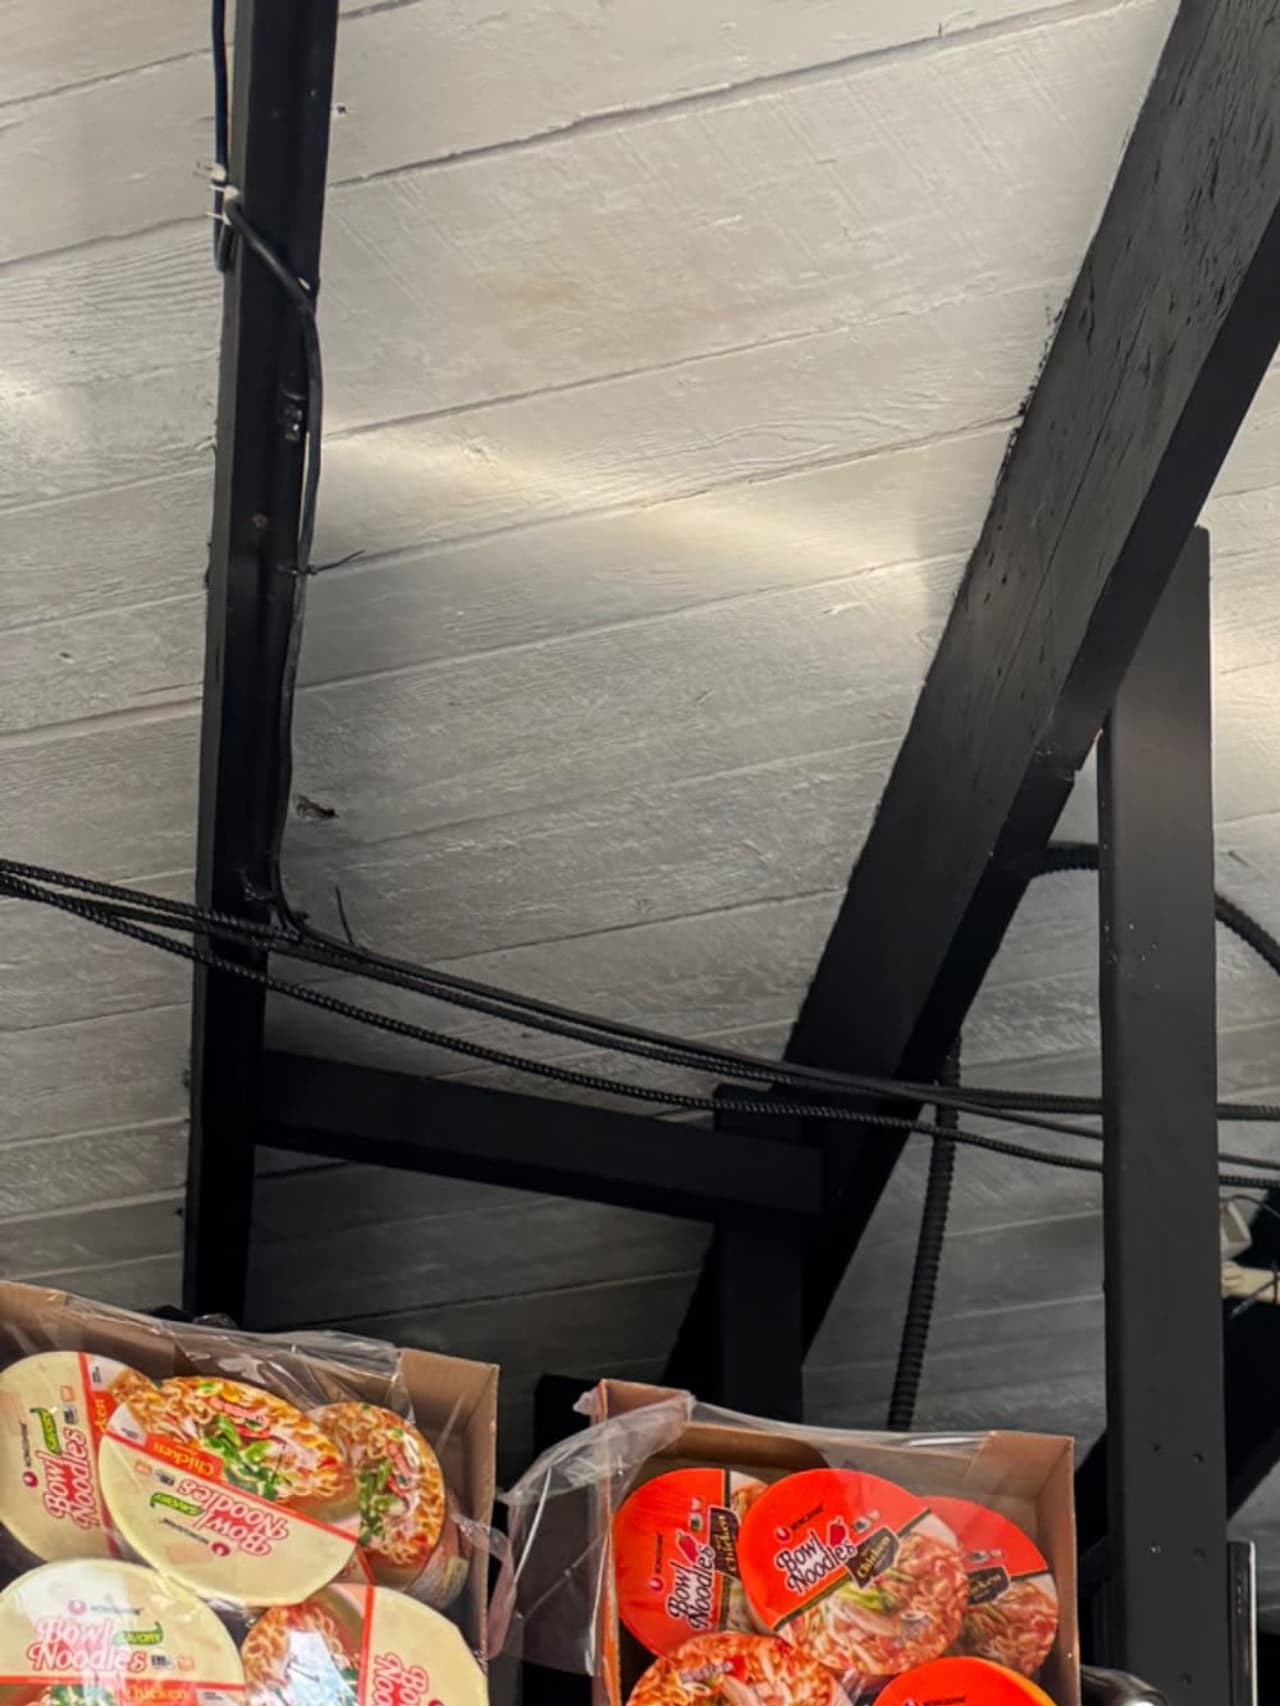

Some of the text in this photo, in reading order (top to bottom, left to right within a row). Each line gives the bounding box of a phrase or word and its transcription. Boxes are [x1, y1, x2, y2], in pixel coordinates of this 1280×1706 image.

[35, 1450, 71, 1519] Bowl
[62, 1426, 100, 1531] Noodles
[177, 1478, 290, 1541] Noodles
[193, 1511, 272, 1557] Bowl
[776, 1529, 825, 1572] Bowl
[787, 1539, 858, 1594] Noodles
[855, 1534, 891, 1580] Chicken
[667, 1560, 691, 1618] Bowl
[688, 1544, 716, 1629] Noodles
[28, 1643, 147, 1672] Noodles
[36, 1617, 117, 1649] Bowl
